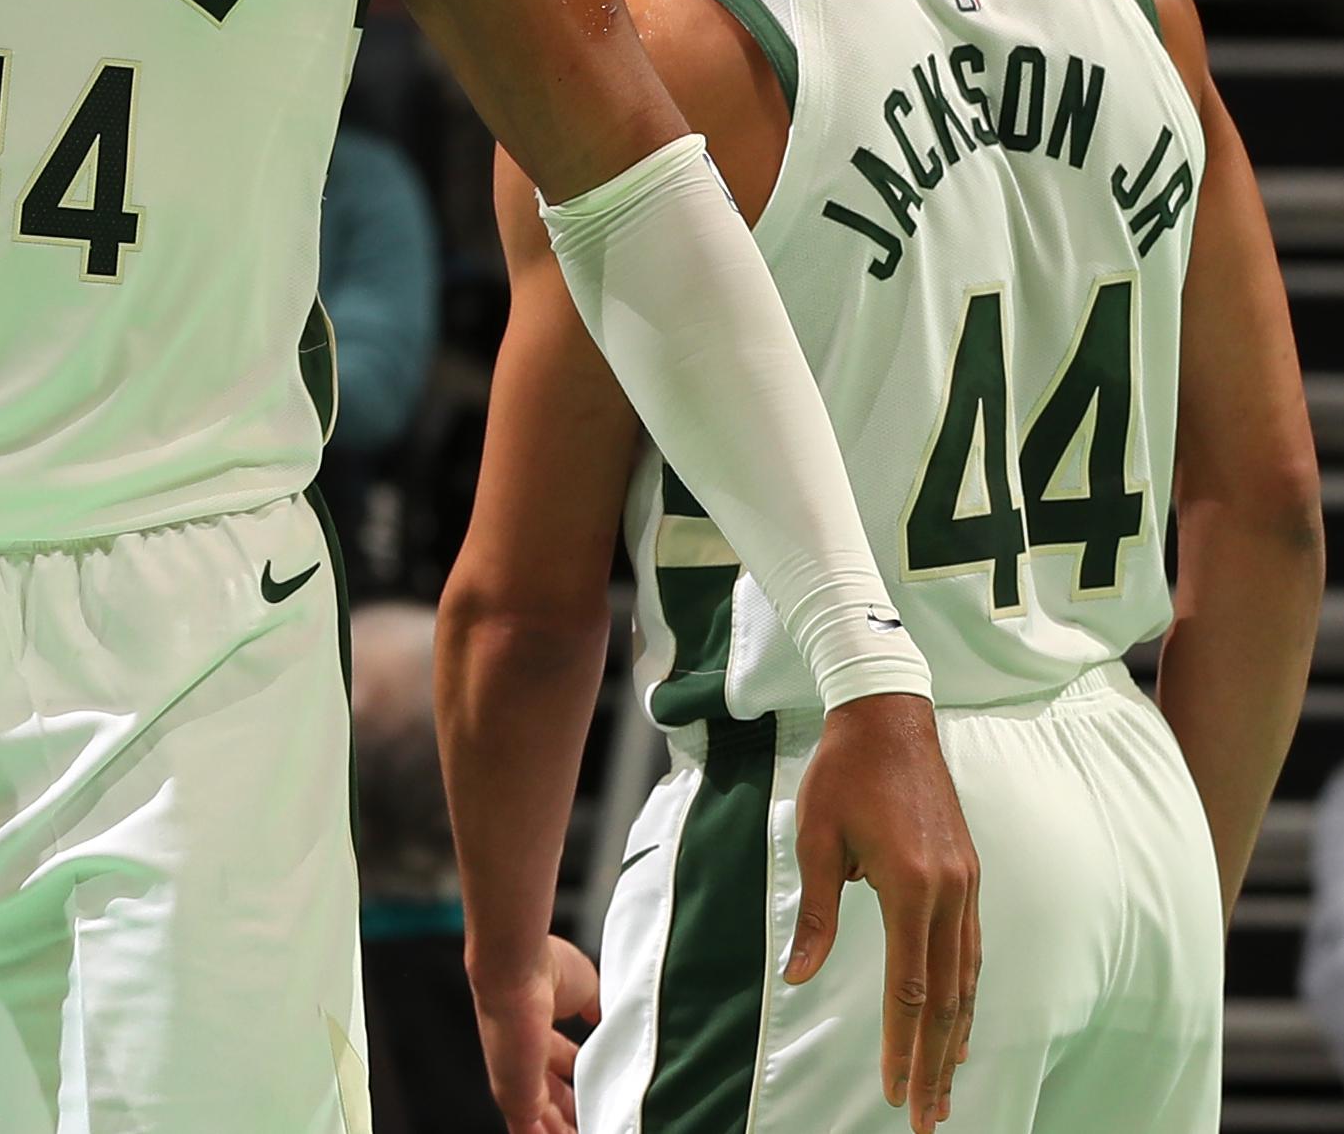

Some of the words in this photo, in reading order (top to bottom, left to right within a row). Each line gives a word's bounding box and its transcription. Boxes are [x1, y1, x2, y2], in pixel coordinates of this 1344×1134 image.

[822, 43, 1106, 282] JACKSON
[1110, 125, 1195, 259] JR
[897, 271, 1151, 621] 44
